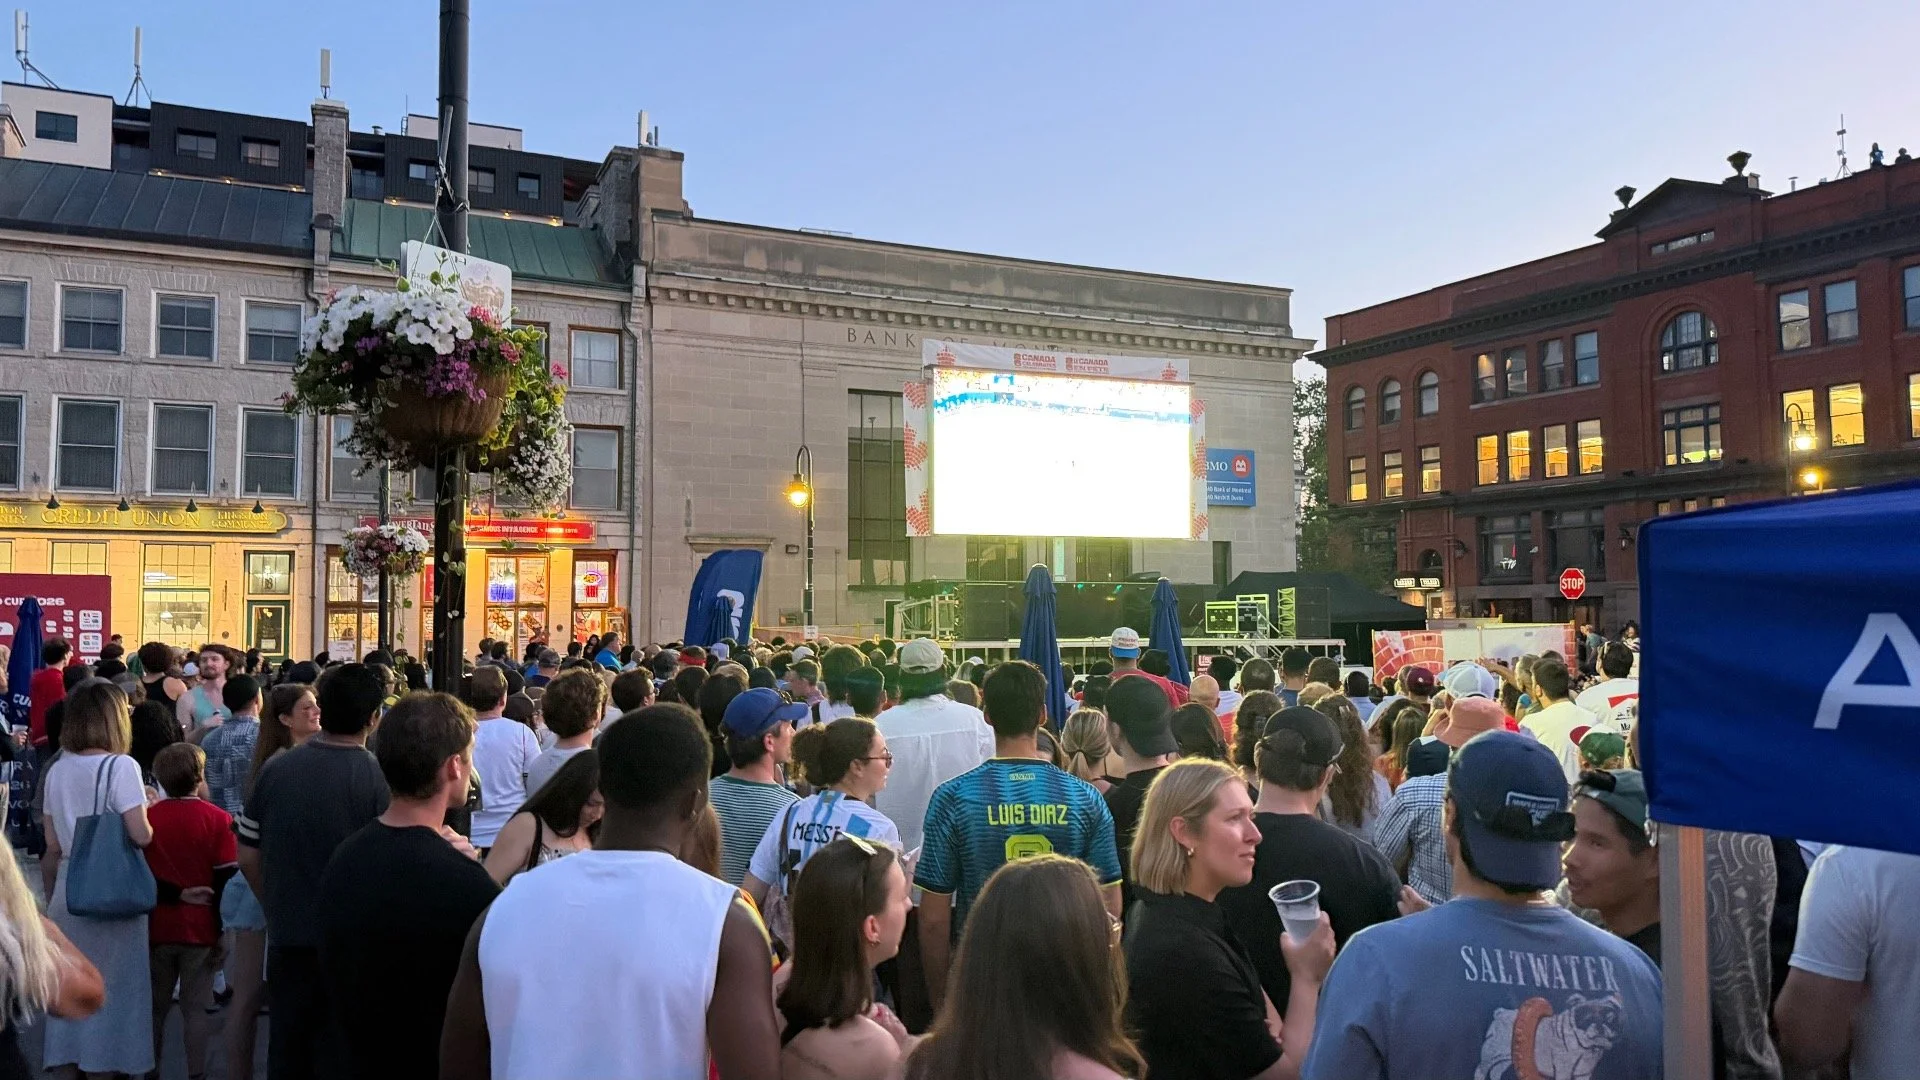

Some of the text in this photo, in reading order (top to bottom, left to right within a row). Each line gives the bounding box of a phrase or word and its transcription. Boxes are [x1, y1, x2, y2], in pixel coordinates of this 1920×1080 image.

[847, 328, 916, 348] BANK
[1021, 354, 1056, 363] CANADA
[1079, 358, 1108, 366] CANADA
[41, 508, 119, 525] CREDIT
[131, 510, 201, 527] UNION
[1561, 577, 1584, 590] STOP
[36, 597, 65, 606] 026
[13, 693, 32, 707] CU
[987, 803, 1069, 826] LUIS DIAZ
[1460, 945, 1621, 992] SALTWATER
